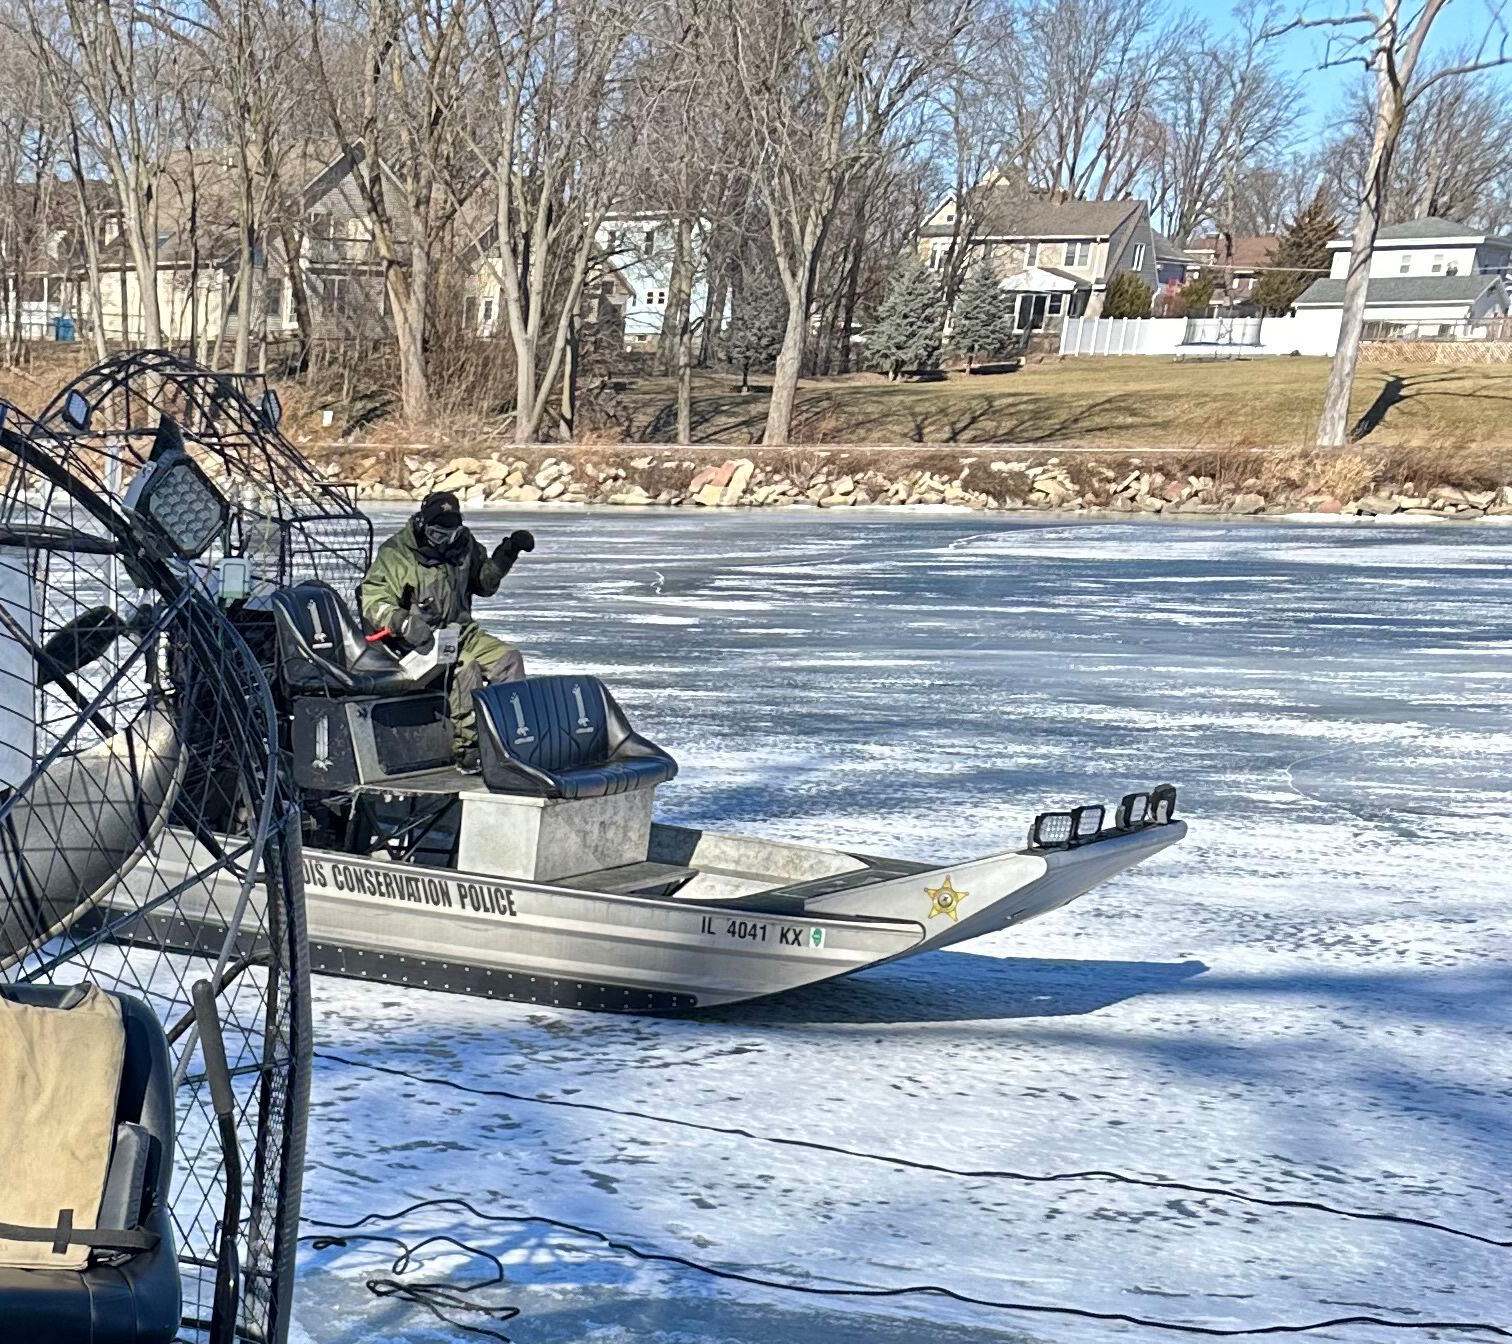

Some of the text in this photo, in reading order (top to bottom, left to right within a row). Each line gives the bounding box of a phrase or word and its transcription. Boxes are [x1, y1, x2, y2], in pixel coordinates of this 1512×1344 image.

[332, 863, 453, 908] CONSERVATION
[458, 882, 517, 917] POLICE
[701, 915, 803, 947] IL 4041 KX
